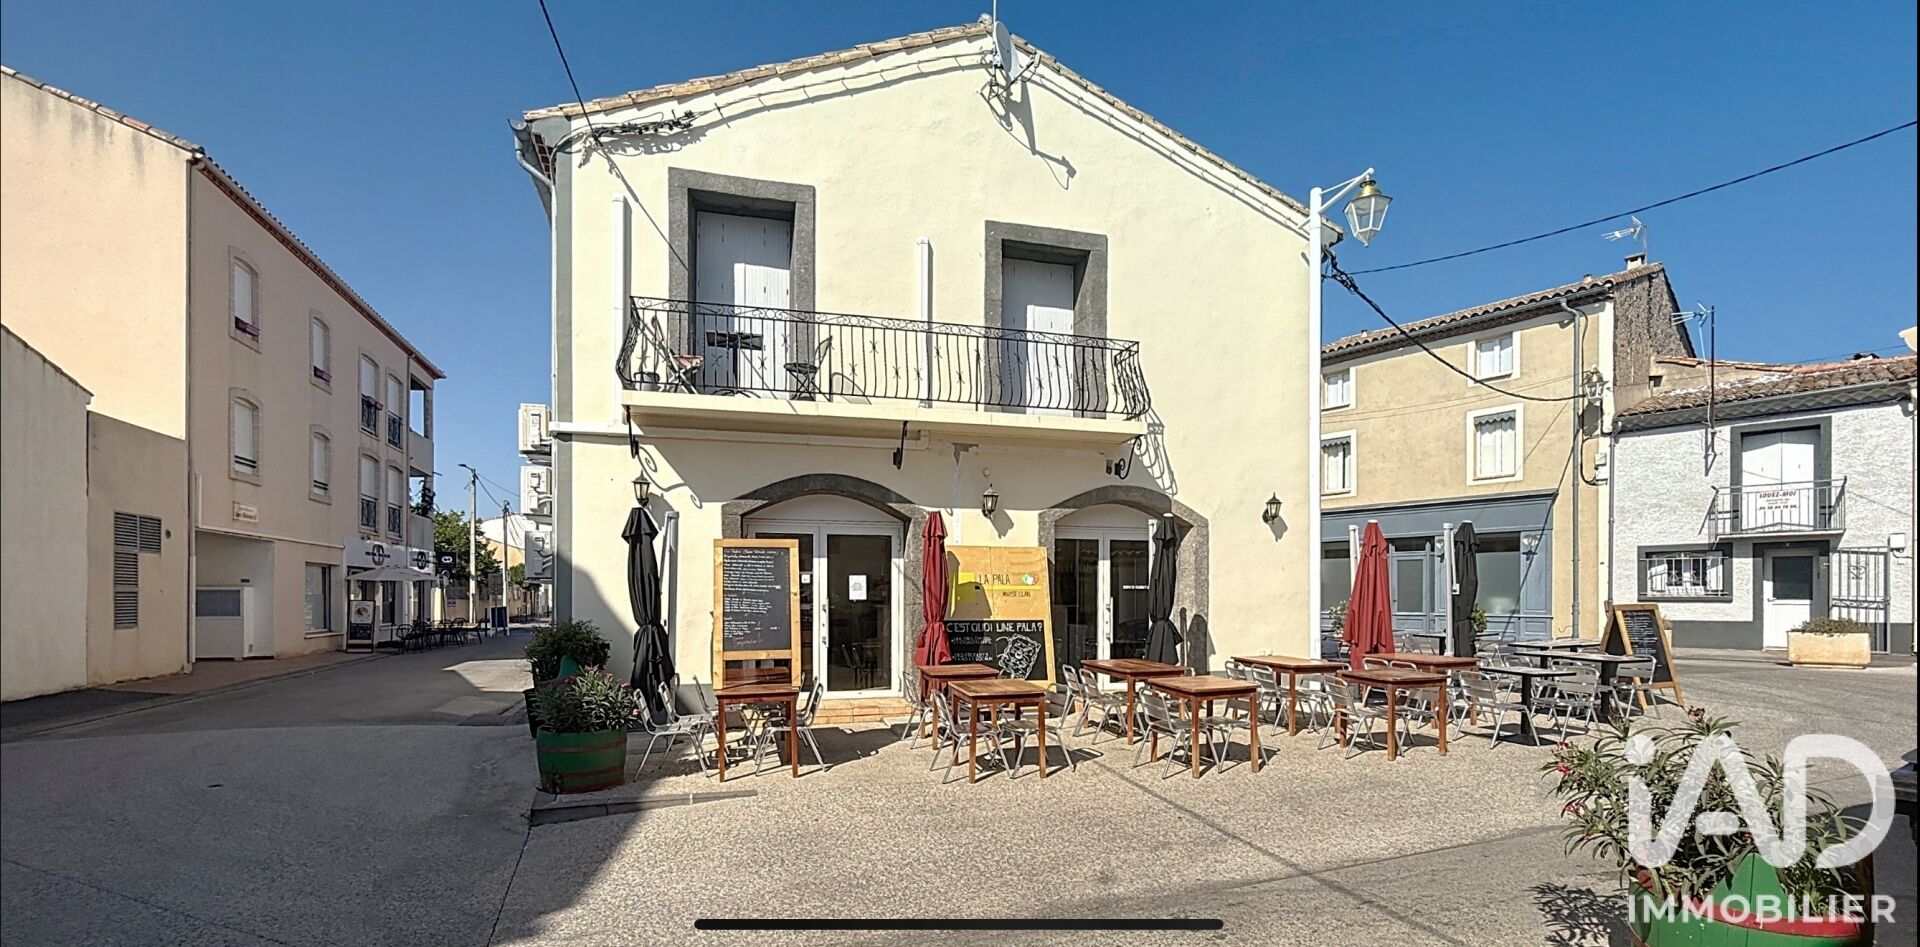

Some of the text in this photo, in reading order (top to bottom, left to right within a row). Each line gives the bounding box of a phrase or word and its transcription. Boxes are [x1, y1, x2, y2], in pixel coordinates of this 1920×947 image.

[979, 573, 1011, 585] LA PALA
[971, 622, 993, 632] QUOI
[996, 622, 1015, 632] UNE
[1016, 622, 1043, 632] PALA?
